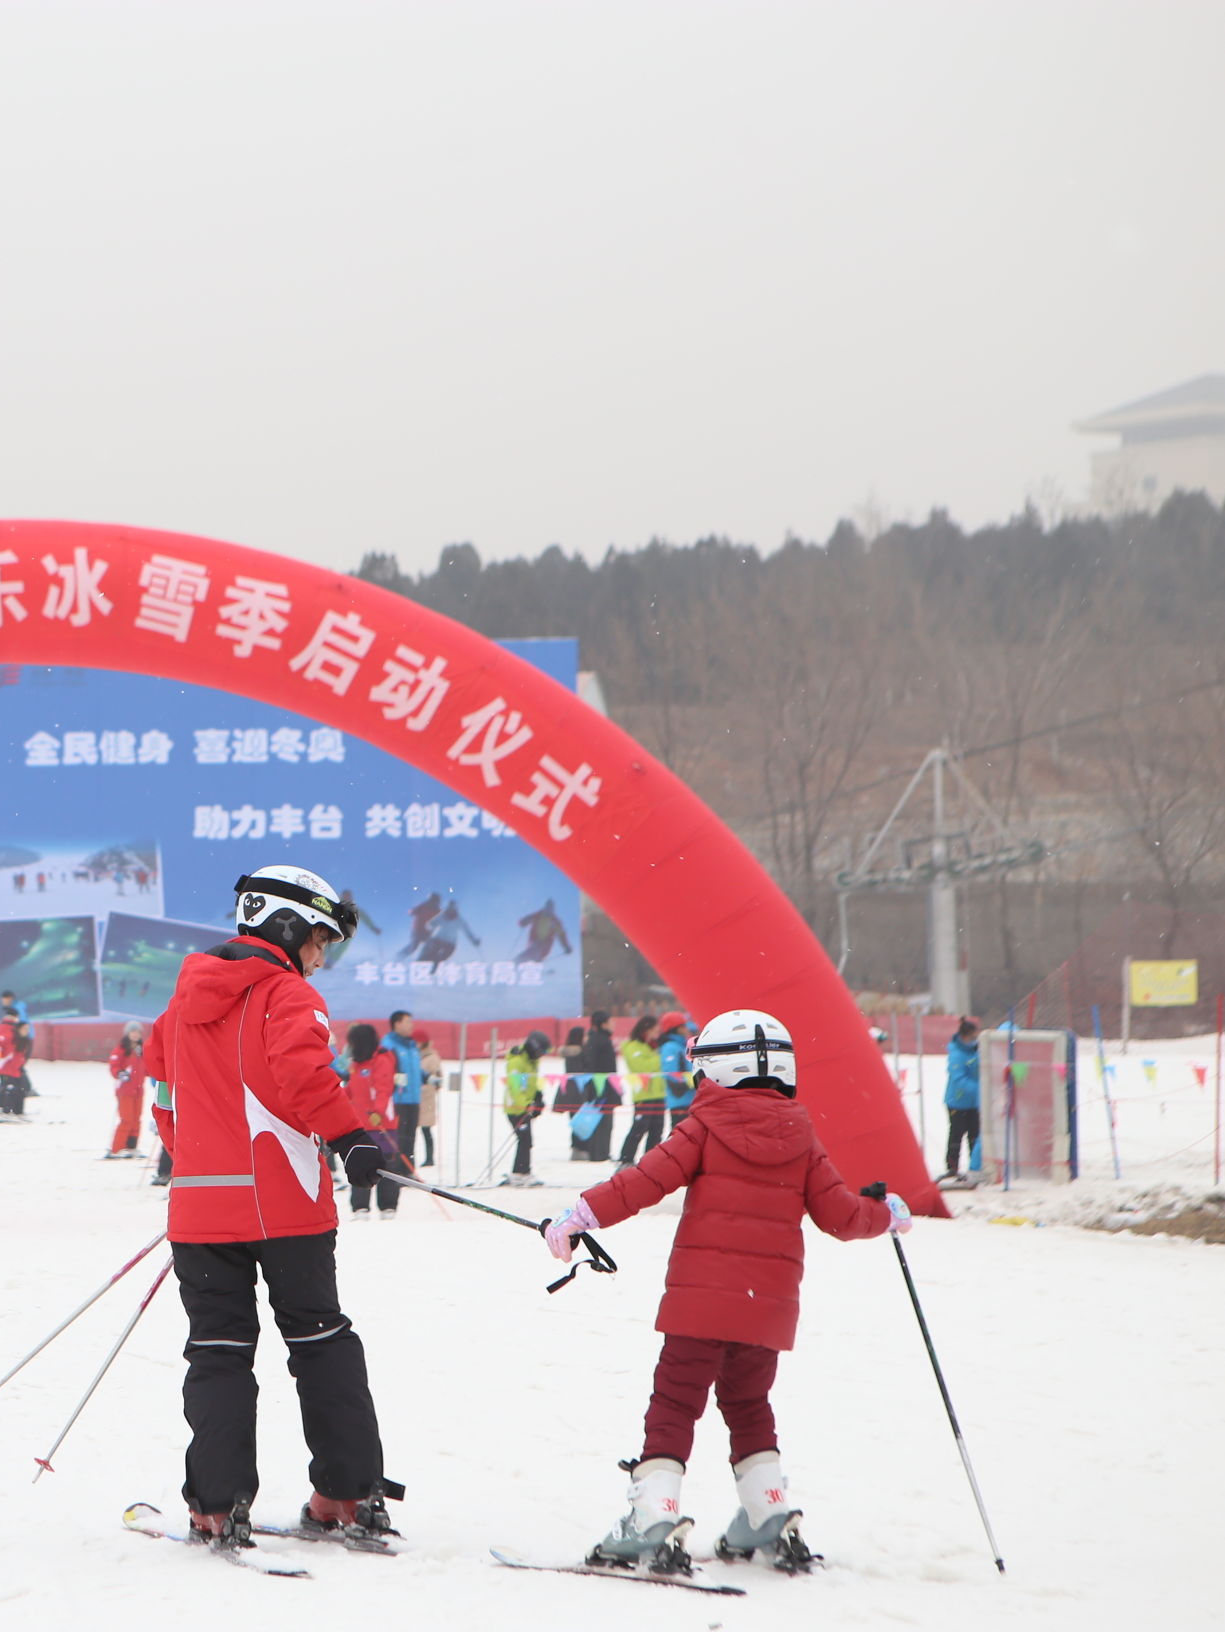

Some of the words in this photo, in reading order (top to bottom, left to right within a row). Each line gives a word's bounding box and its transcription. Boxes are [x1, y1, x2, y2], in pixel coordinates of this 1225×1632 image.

[24, 729, 174, 766] 全民健身
[193, 727, 346, 764] 喜迎冬奥
[193, 803, 344, 839] 助力丰台
[355, 961, 544, 986] 丰台区体育局宣
